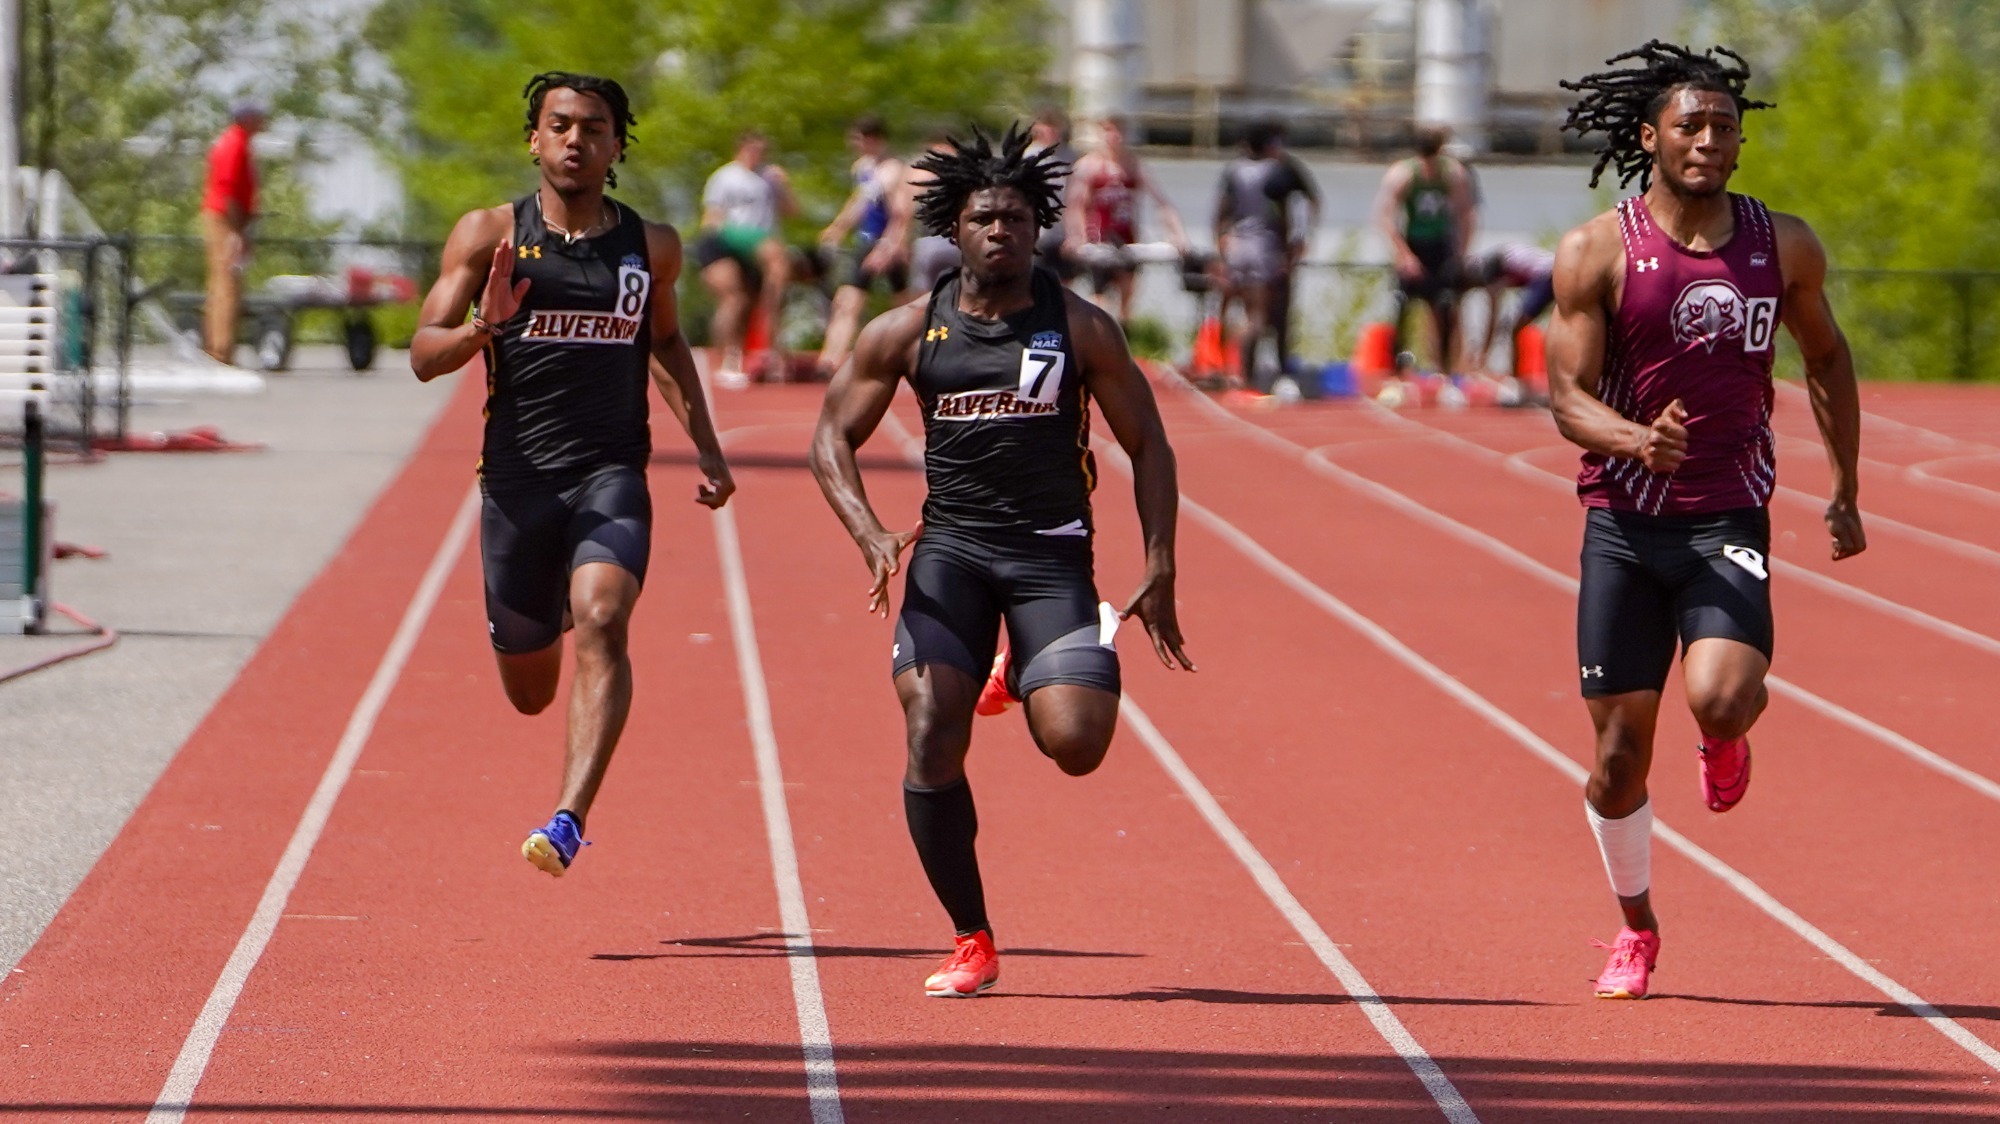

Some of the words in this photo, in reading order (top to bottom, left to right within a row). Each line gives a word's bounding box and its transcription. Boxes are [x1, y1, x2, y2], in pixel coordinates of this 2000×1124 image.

[621, 272, 644, 317] 8
[1031, 340, 1059, 349] MAC
[1750, 301, 1771, 347] 6
[1028, 353, 1058, 399] 7
